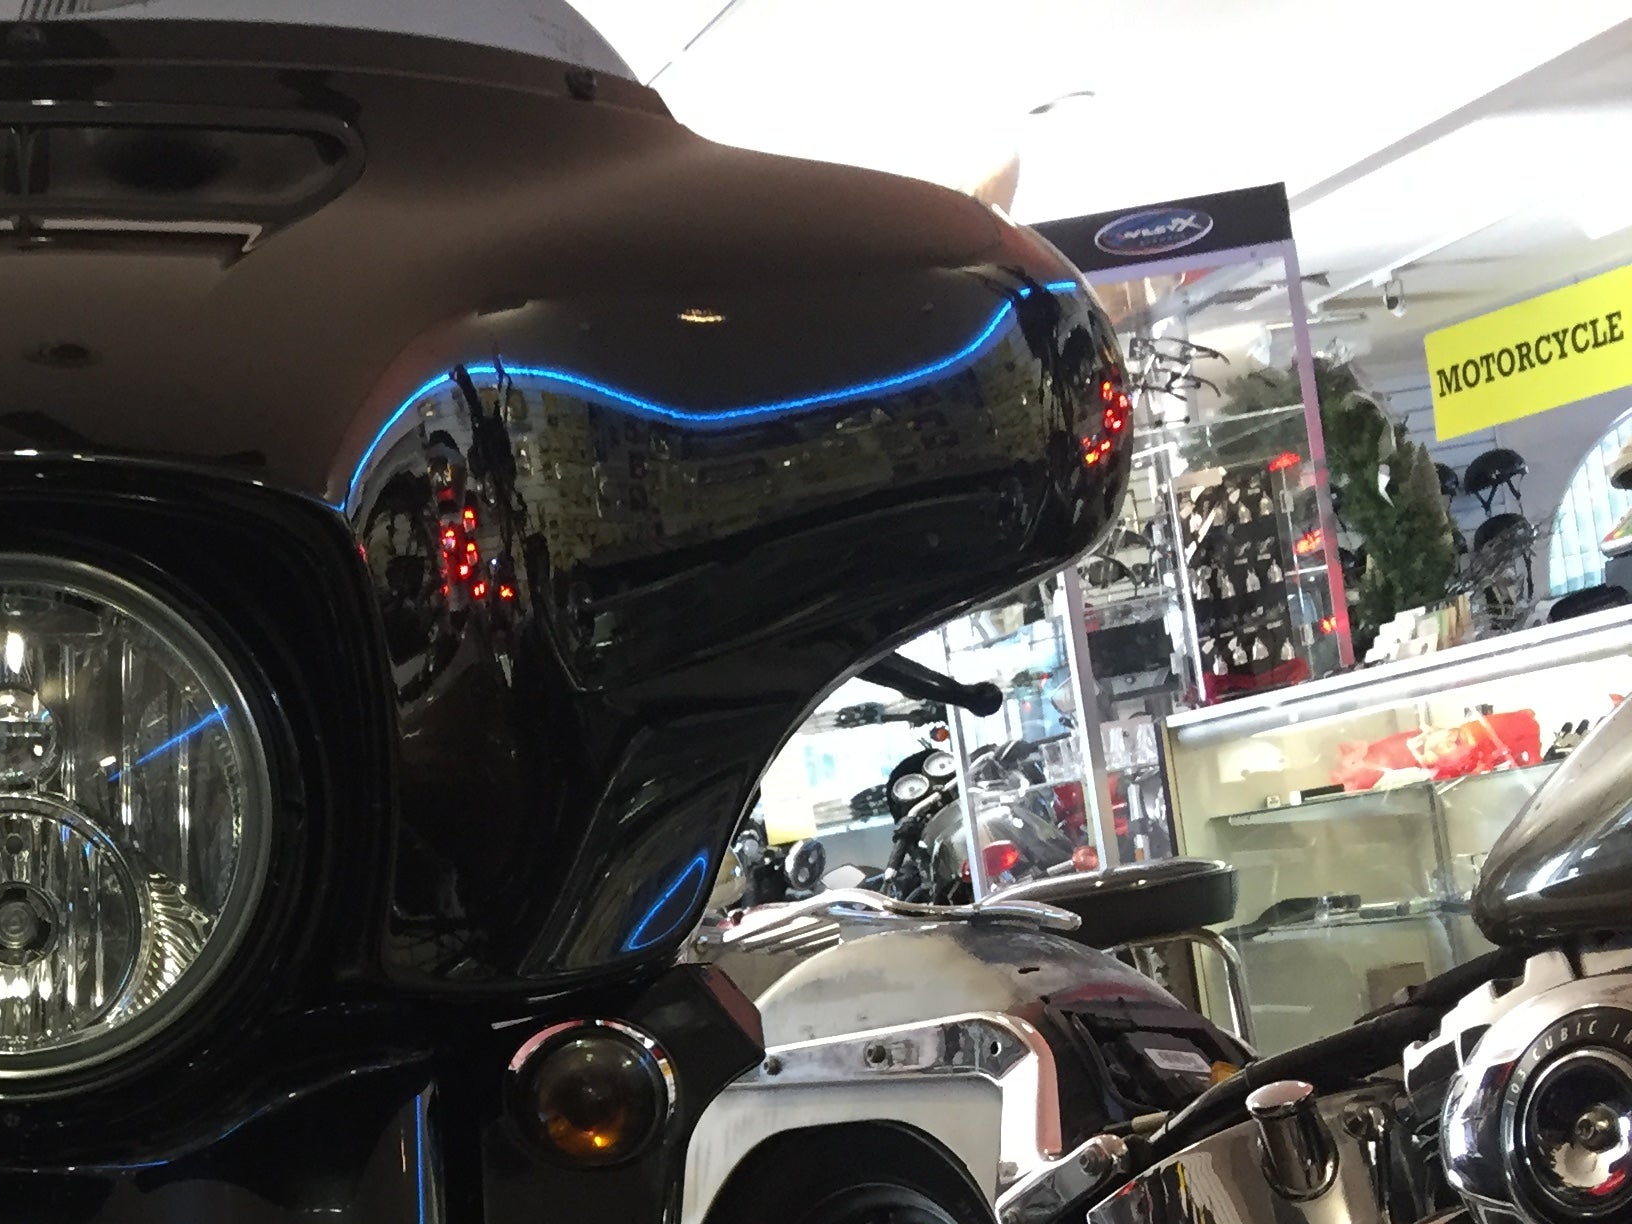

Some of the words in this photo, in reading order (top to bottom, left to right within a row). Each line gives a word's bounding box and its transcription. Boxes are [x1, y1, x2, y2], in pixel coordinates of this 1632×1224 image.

[1436, 310, 1625, 398] MOTORCYCLE
[1508, 1068, 1527, 1106] 103
[1532, 1019, 1598, 1062] CUBIC
